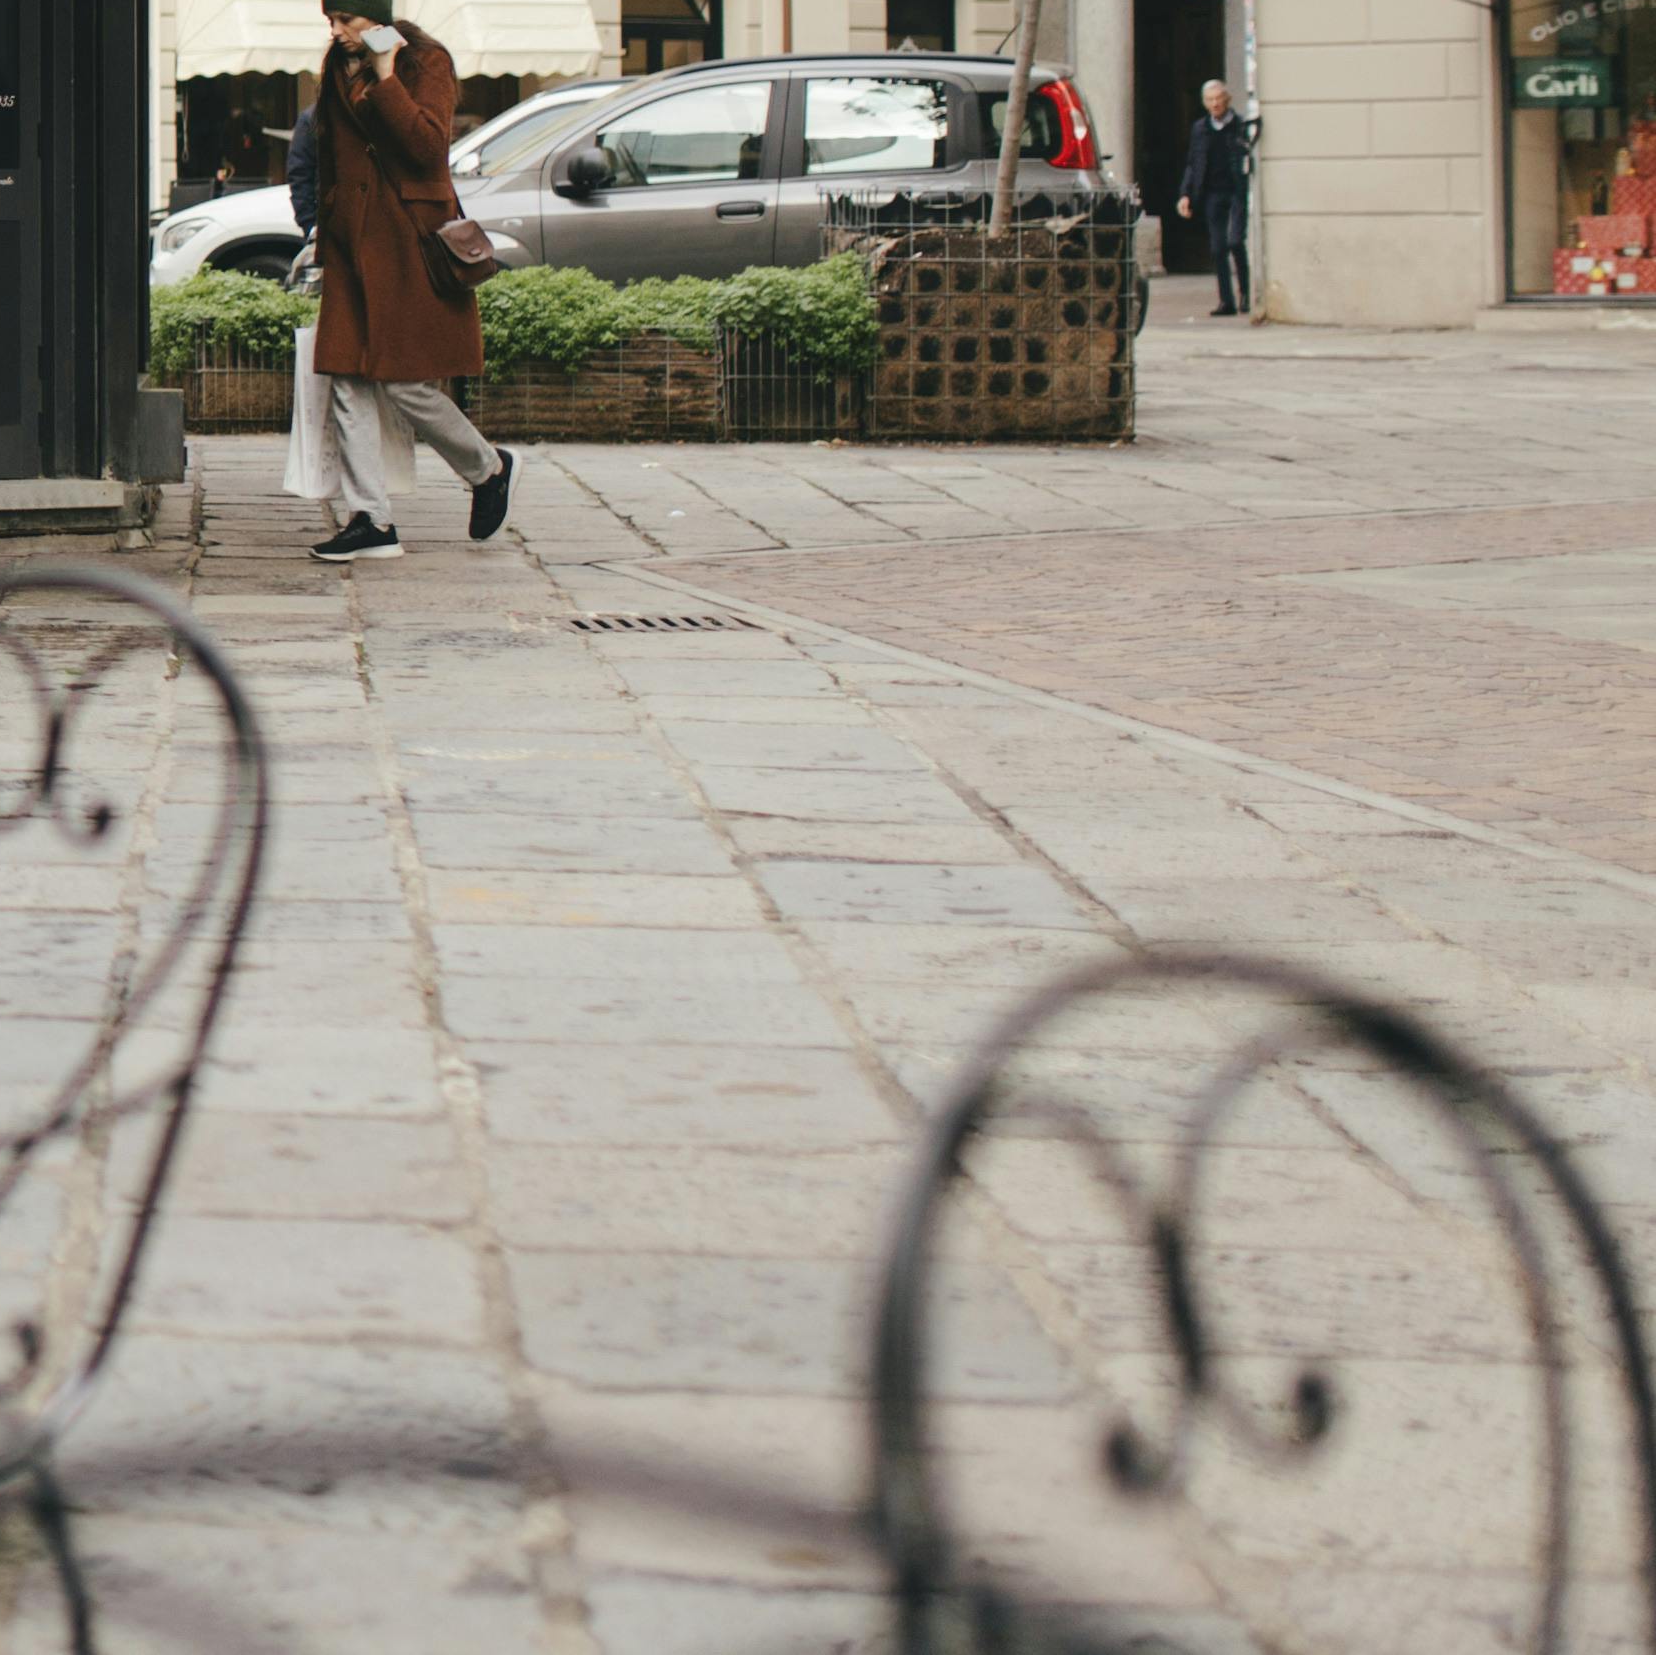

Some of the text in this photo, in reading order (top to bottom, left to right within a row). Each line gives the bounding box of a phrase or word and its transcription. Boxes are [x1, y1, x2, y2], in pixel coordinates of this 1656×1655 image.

[1529, 9, 1579, 44] OLIO
[1583, 1, 1597, 19] E
[1525, 73, 1599, 99] Carli
